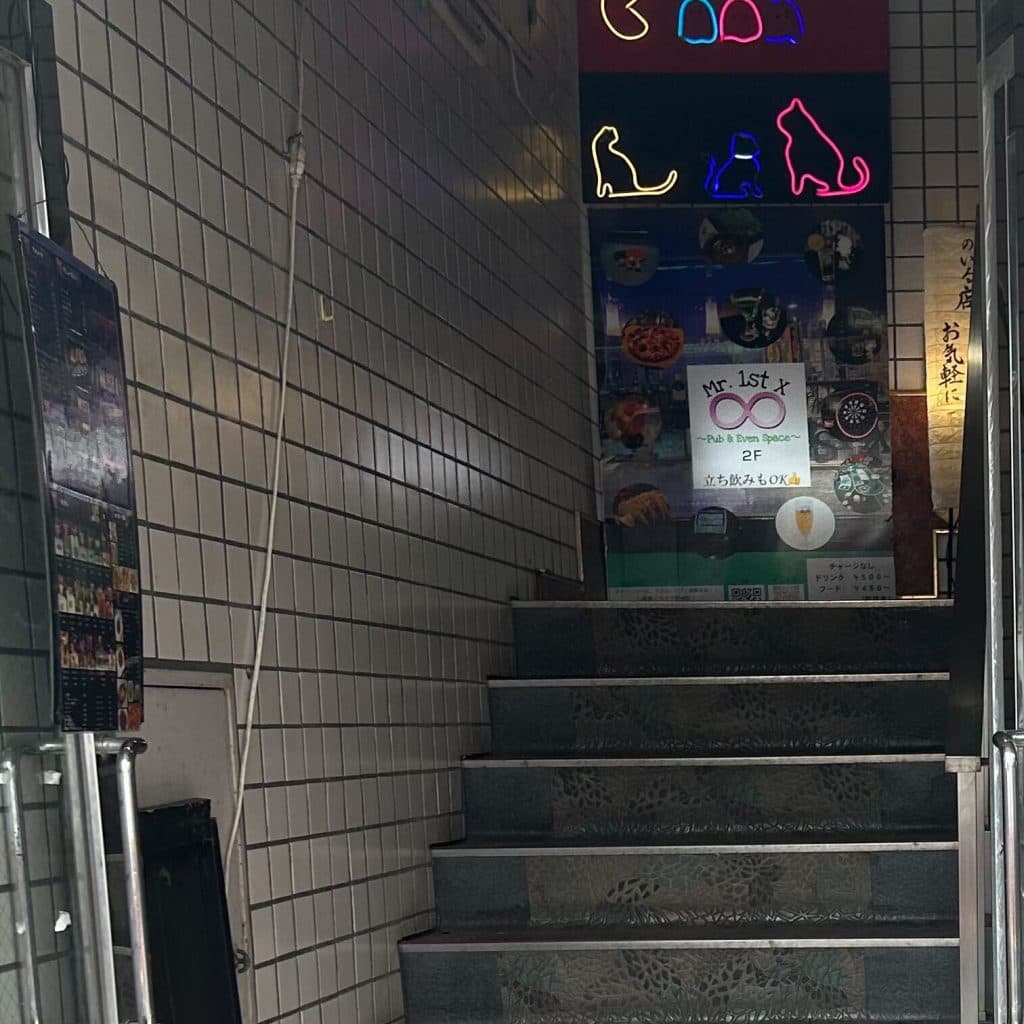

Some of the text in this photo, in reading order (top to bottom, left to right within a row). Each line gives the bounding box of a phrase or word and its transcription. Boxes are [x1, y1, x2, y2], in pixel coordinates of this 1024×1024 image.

[939, 322, 965, 403] お気軽に
[702, 379, 733, 398] Mr.
[738, 370, 770, 390] 1st
[742, 450, 762, 461] 2F
